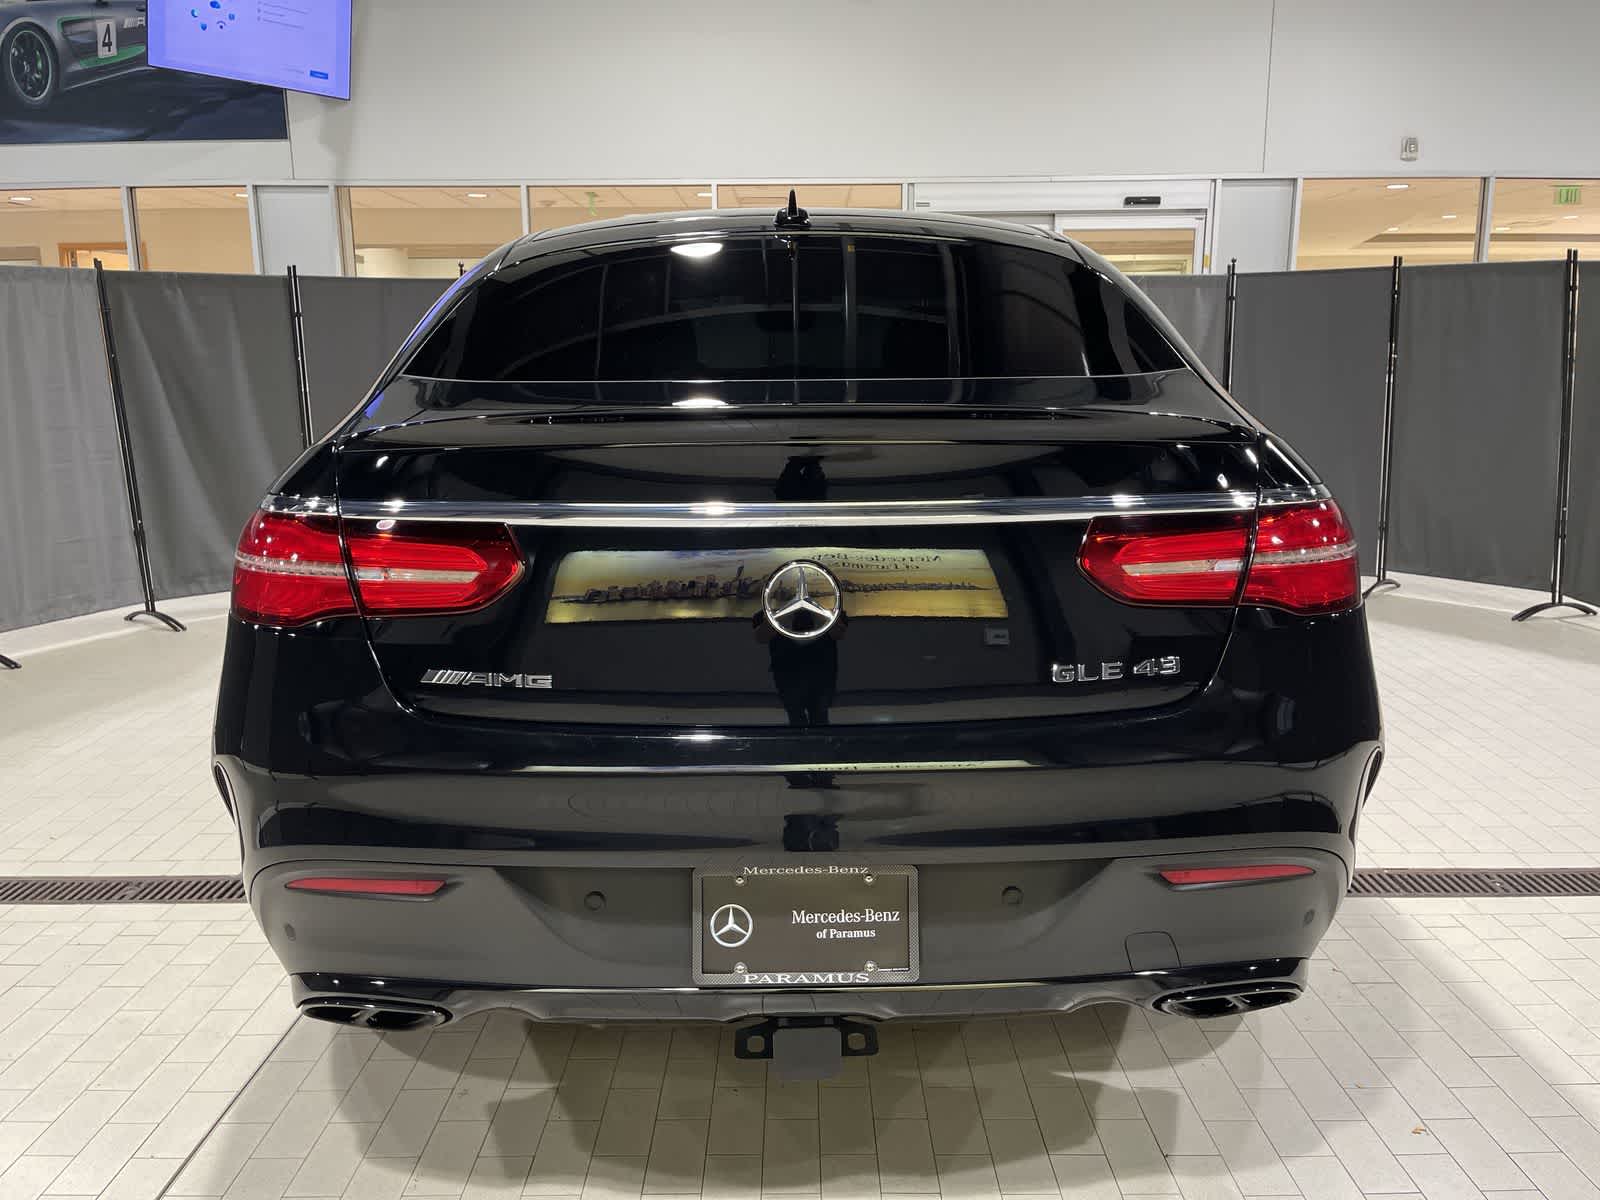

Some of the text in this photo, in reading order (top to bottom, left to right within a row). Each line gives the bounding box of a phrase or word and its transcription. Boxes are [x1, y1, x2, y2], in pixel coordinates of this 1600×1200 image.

[102, 23, 112, 52] 4
[1052, 656, 1181, 683] GLE 43
[743, 865, 869, 875] Mercedes-Benz
[791, 908, 901, 924] Mercedes-Benz
[816, 928, 876, 940] of Paramus
[743, 972, 870, 984] PARAMUS
